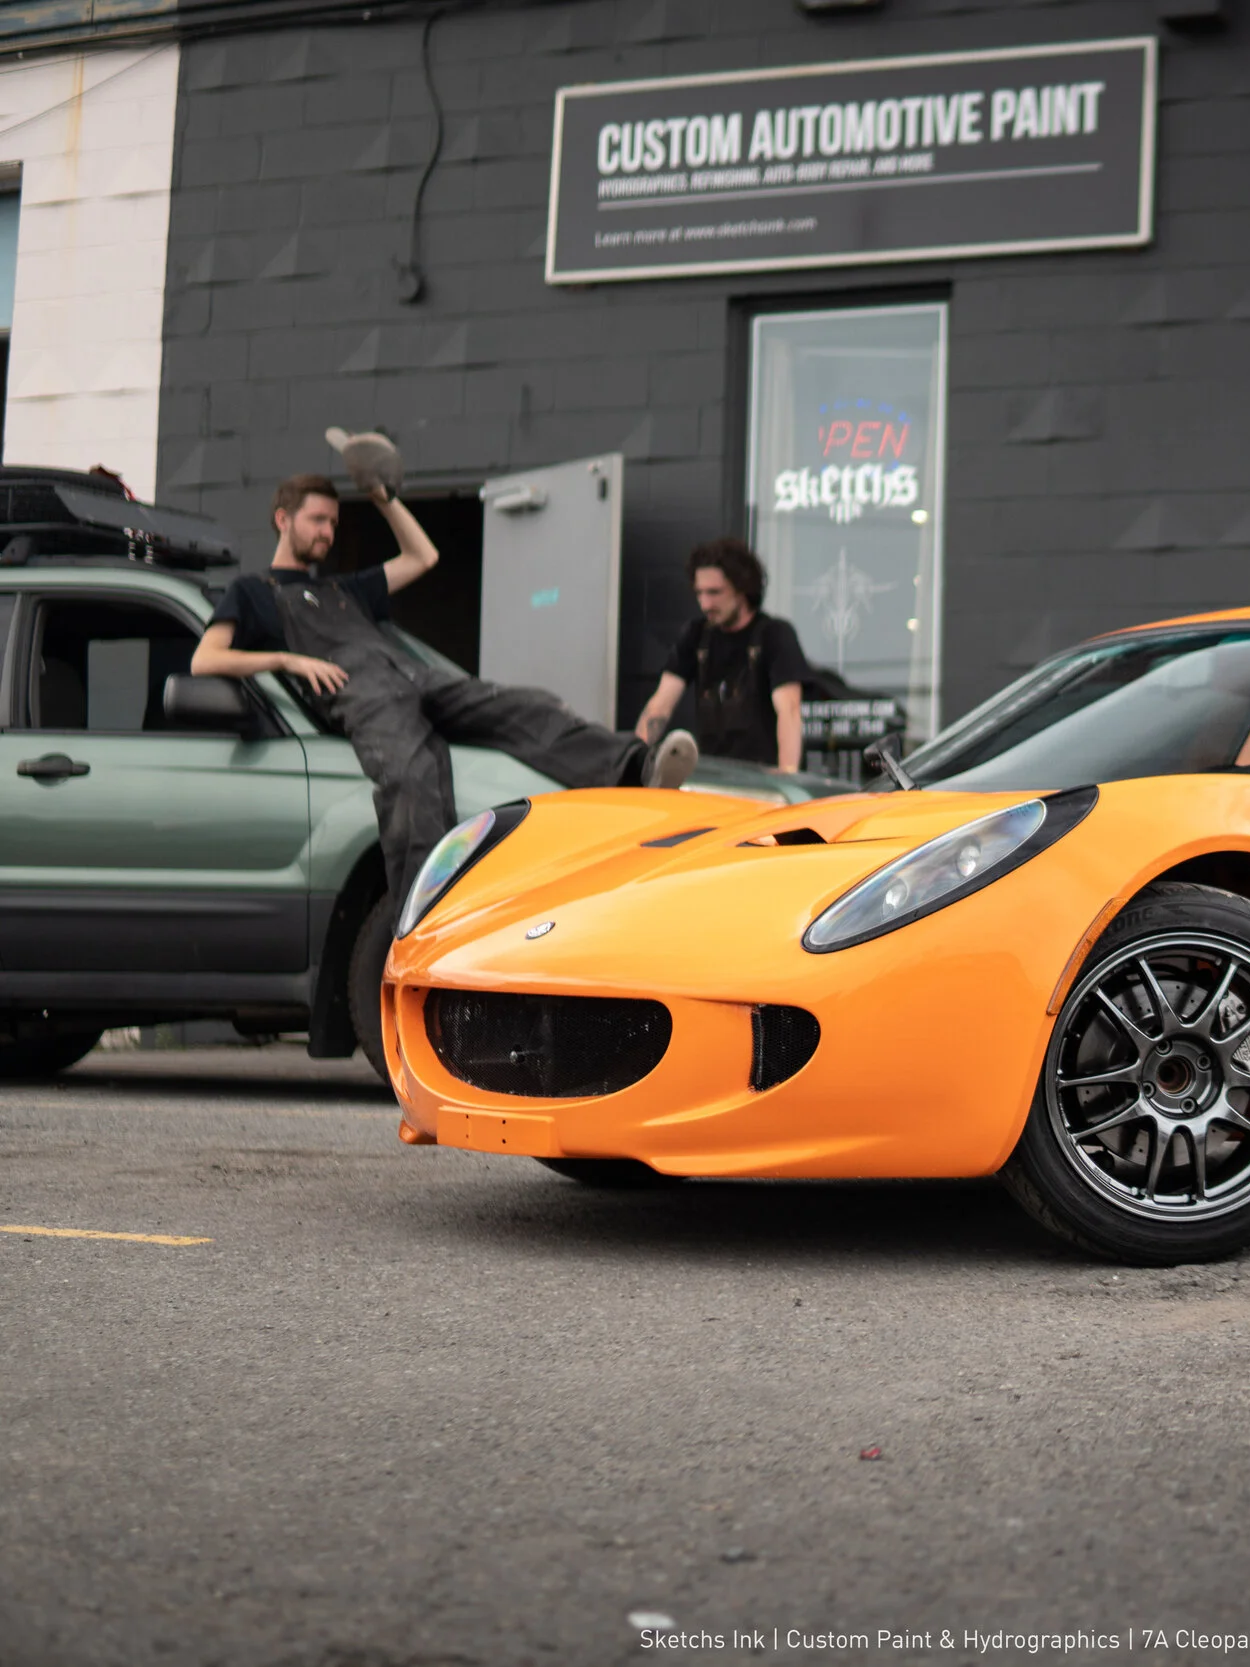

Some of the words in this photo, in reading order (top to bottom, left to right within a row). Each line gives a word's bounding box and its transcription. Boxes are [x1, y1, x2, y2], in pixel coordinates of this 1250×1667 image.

[598, 112, 743, 174] CUSTOM
[748, 91, 984, 162] AUTOMOTIVE
[990, 80, 1106, 142] PAINT
[595, 231, 633, 248] Learn
[633, 228, 668, 246] more
[668, 225, 683, 242] at
[818, 420, 910, 458] PEN
